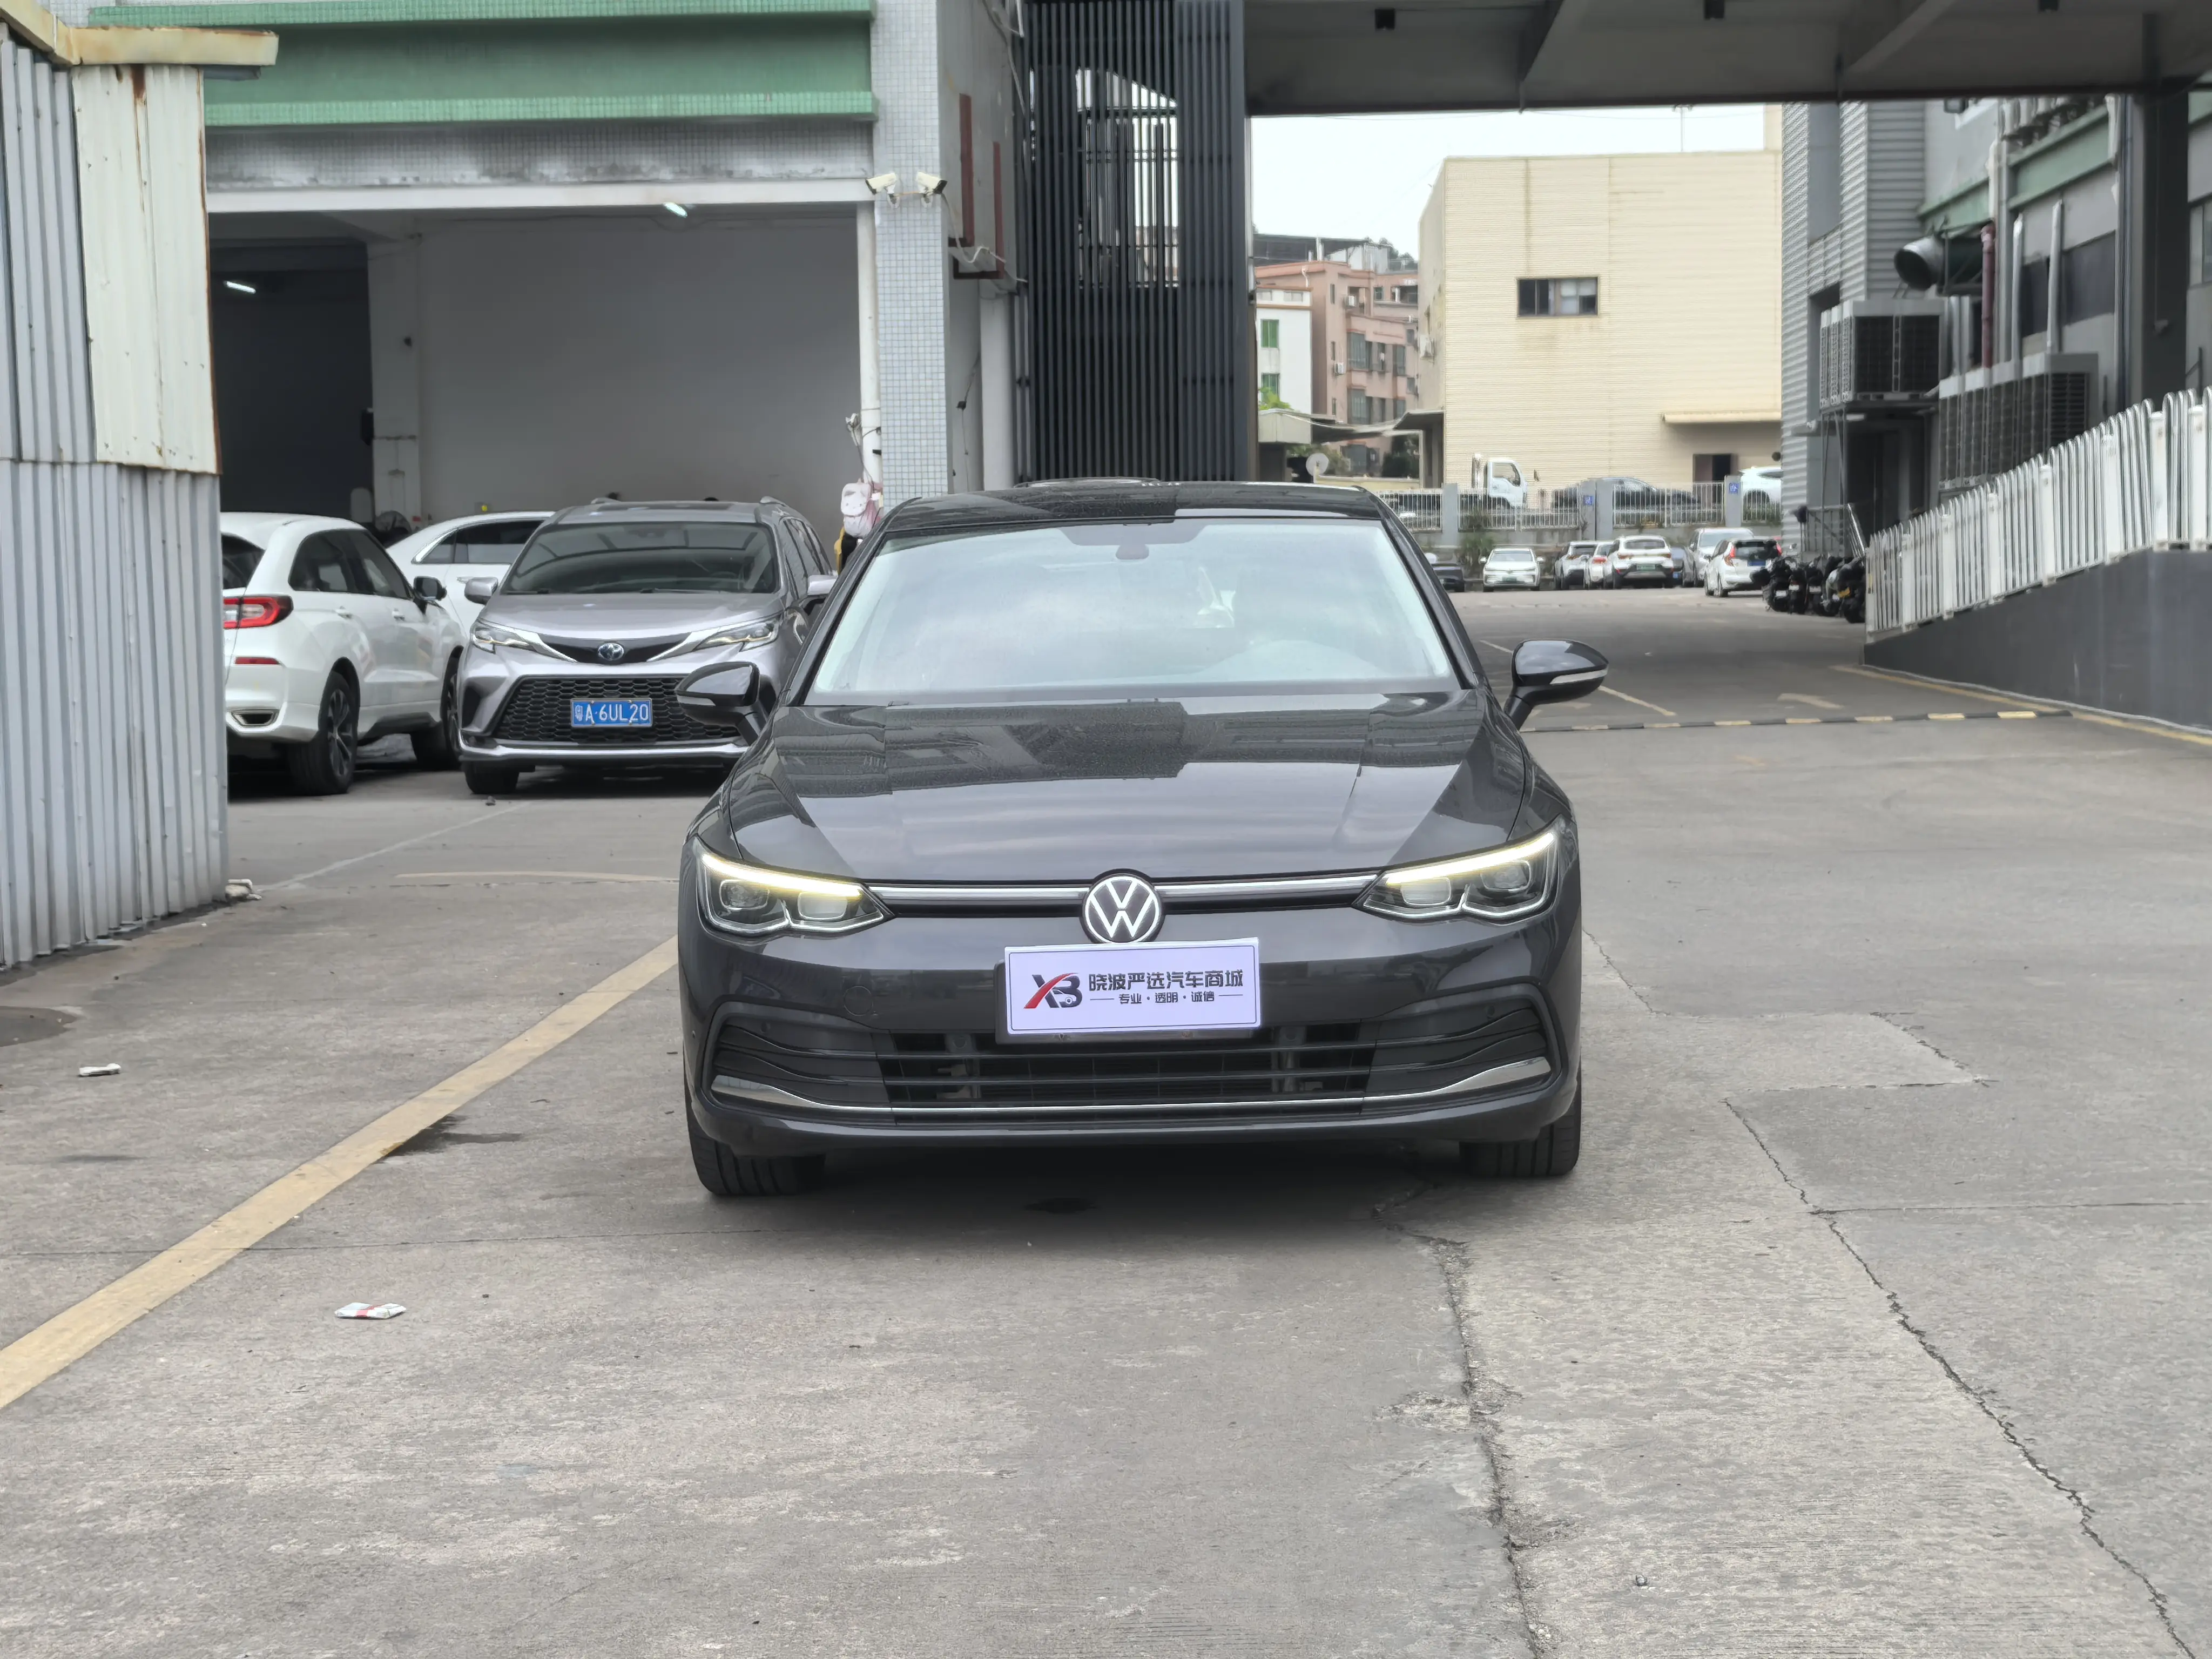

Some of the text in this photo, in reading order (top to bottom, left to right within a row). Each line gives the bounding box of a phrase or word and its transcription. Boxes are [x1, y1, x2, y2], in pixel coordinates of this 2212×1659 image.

[1087, 878, 1158, 941] VW
[1023, 973, 1082, 1009] XB
[1089, 969, 1243, 992] 晓波严选汽车商城
